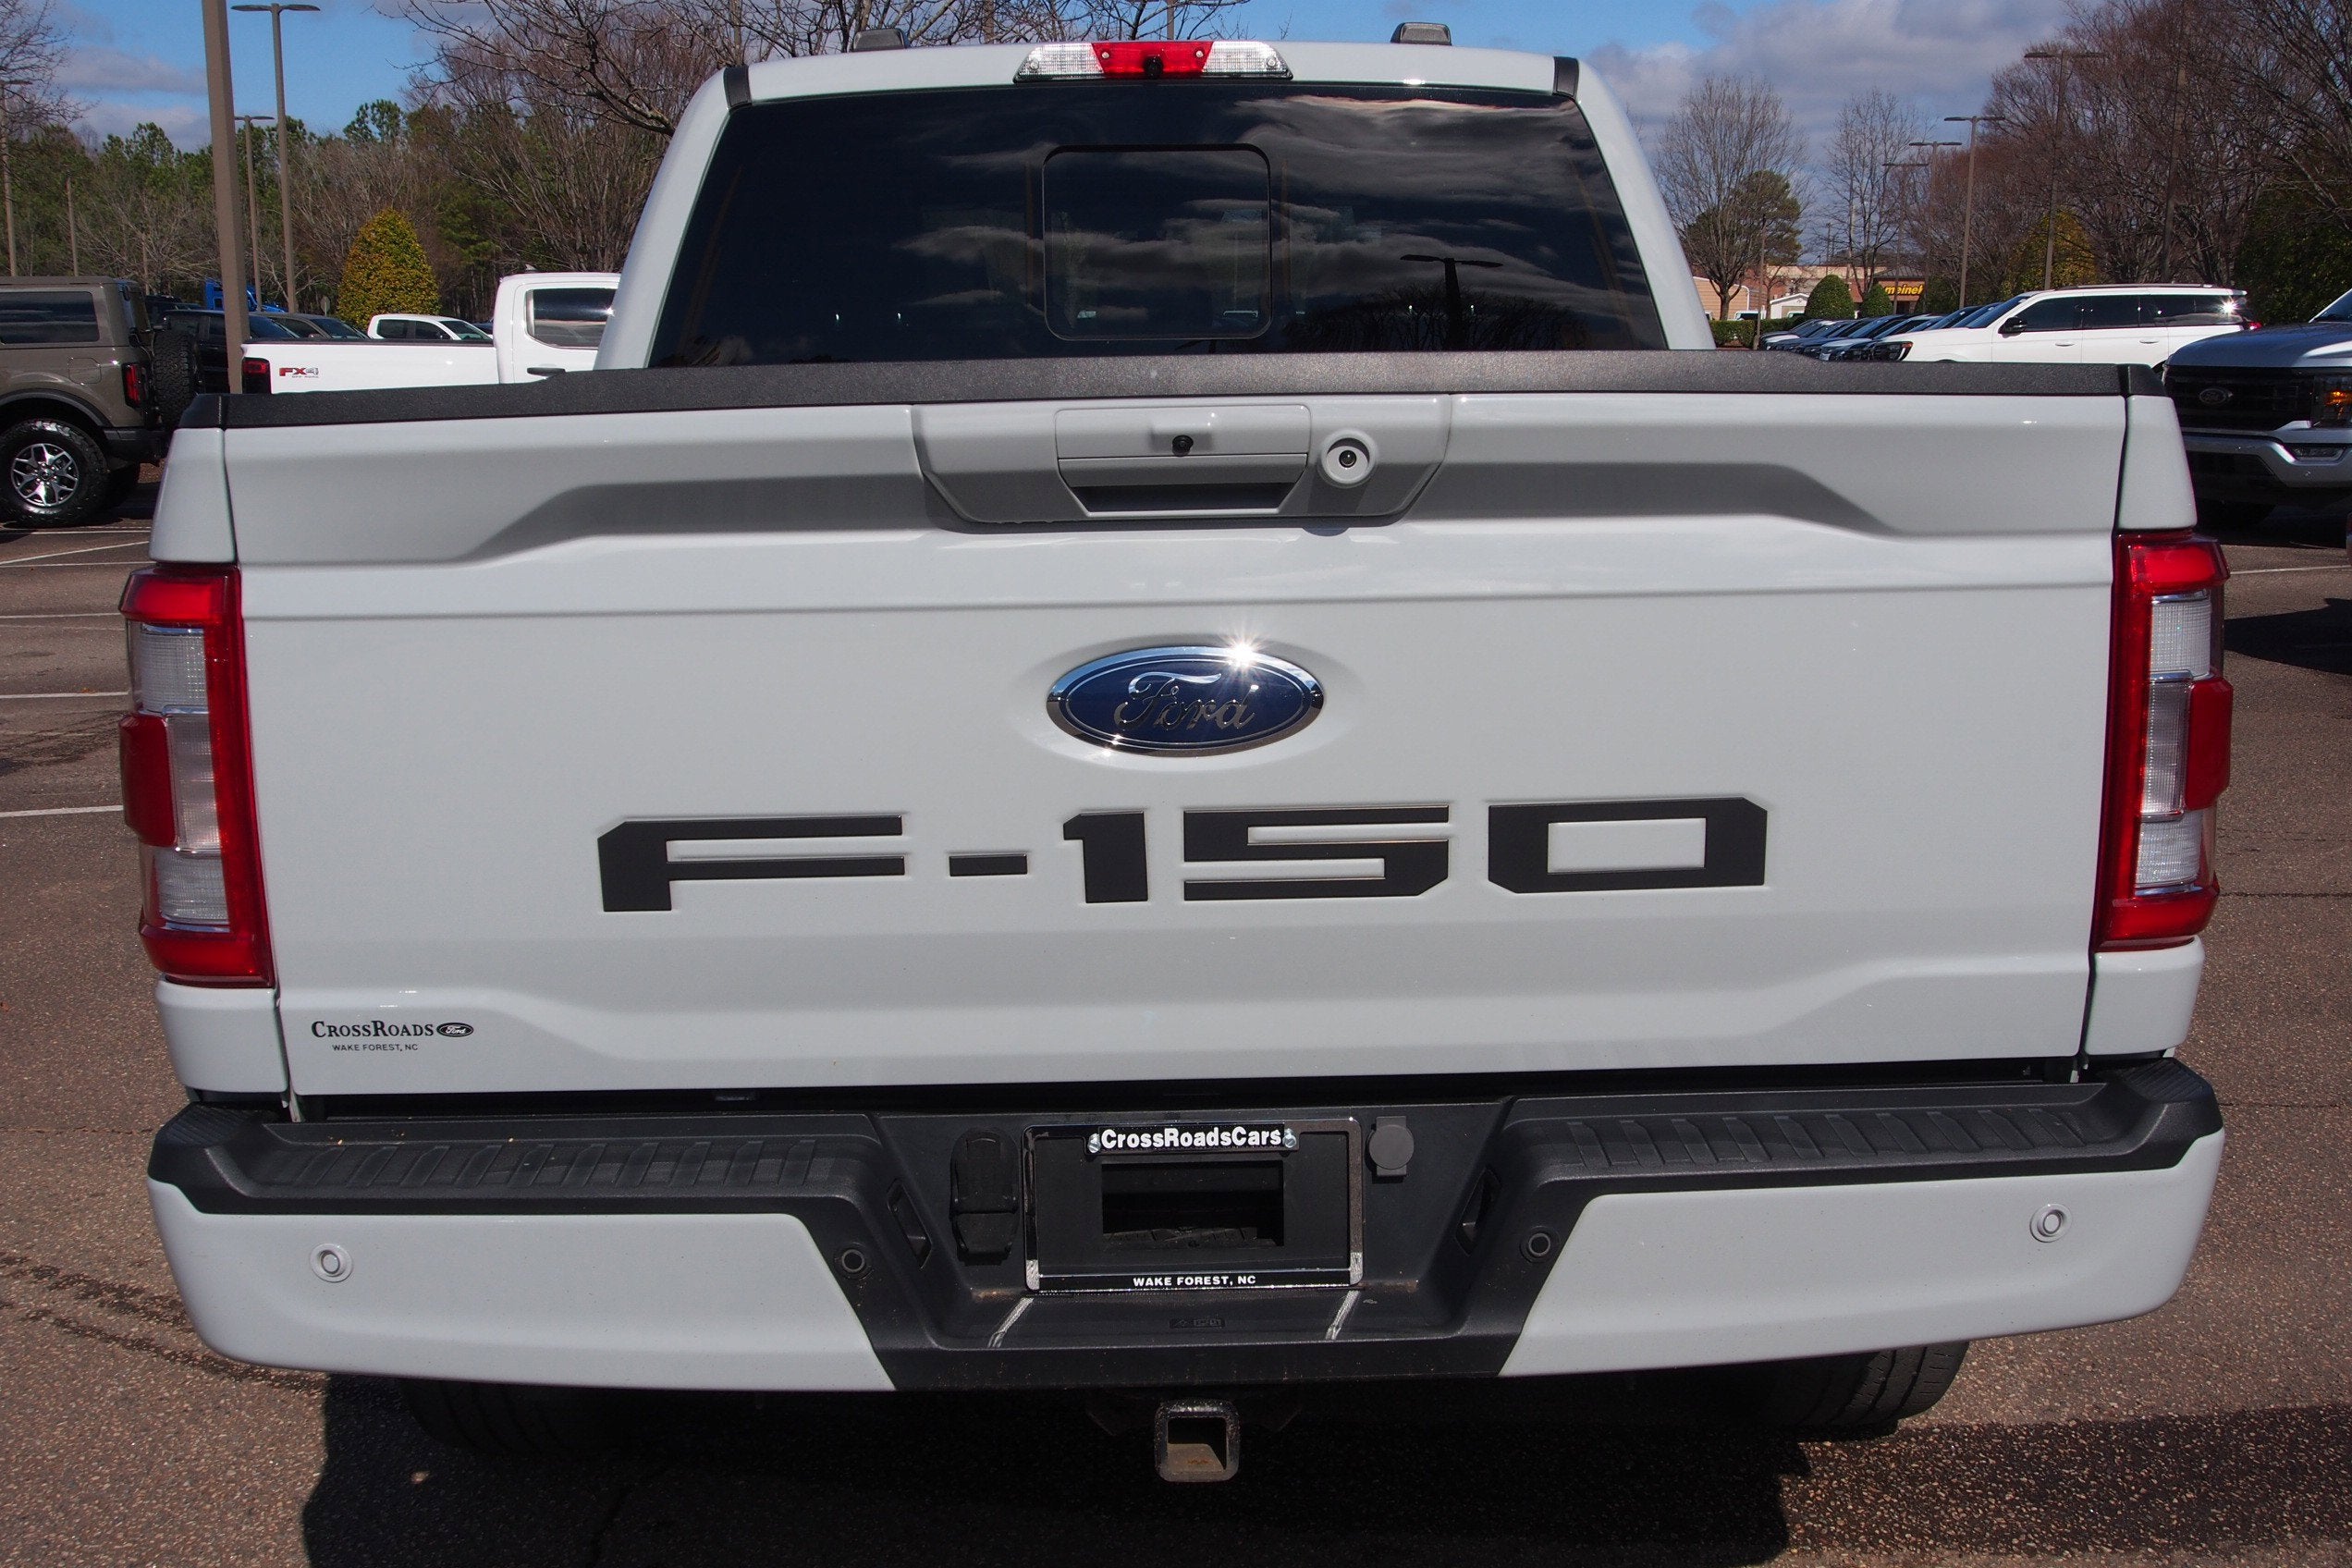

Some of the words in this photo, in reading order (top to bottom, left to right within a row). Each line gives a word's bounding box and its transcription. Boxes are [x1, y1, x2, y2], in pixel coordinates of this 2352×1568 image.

[279, 367, 319, 376] FX4
[1113, 671, 1259, 722] Ford
[597, 796, 1768, 912] F-150
[362, 1043, 403, 1052] FOREST,
[405, 1043, 419, 1051] NC
[1100, 1125, 1282, 1148] CrossRoadsCars
[1133, 1277, 1172, 1287] WAKE
[1176, 1276, 1233, 1286] FOREST,
[1237, 1276, 1256, 1285] NC
